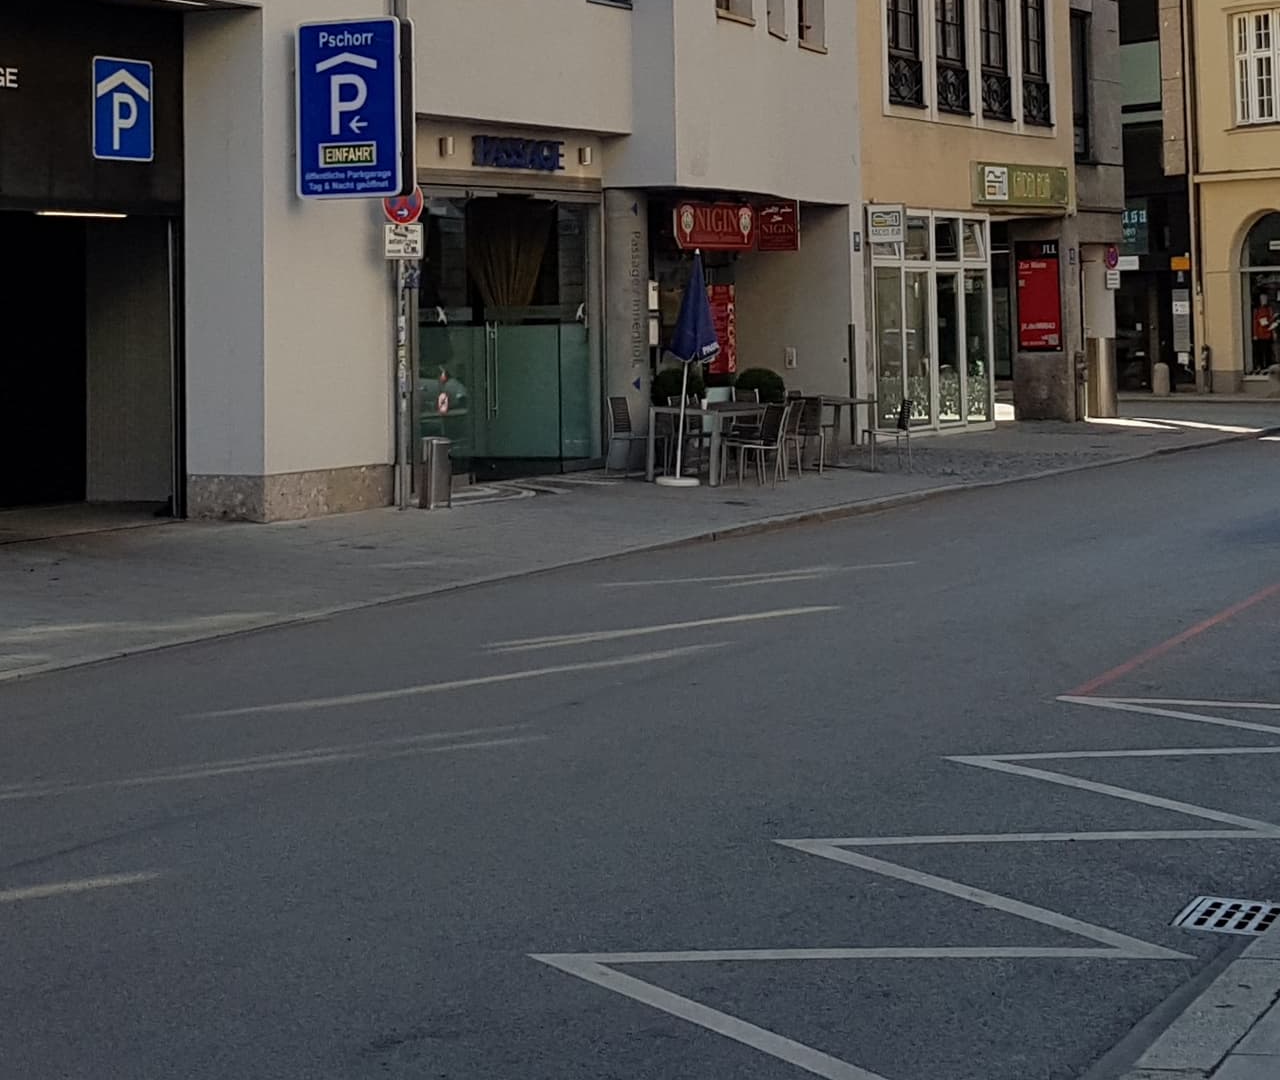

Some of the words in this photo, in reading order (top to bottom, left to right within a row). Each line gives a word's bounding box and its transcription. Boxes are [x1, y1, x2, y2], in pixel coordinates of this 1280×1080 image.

[319, 30, 373, 48] Pschorr
[329, 73, 368, 135] P
[112, 92, 138, 150] P
[695, 207, 739, 232] NIGIN
[761, 223, 795, 234] NIGIN
